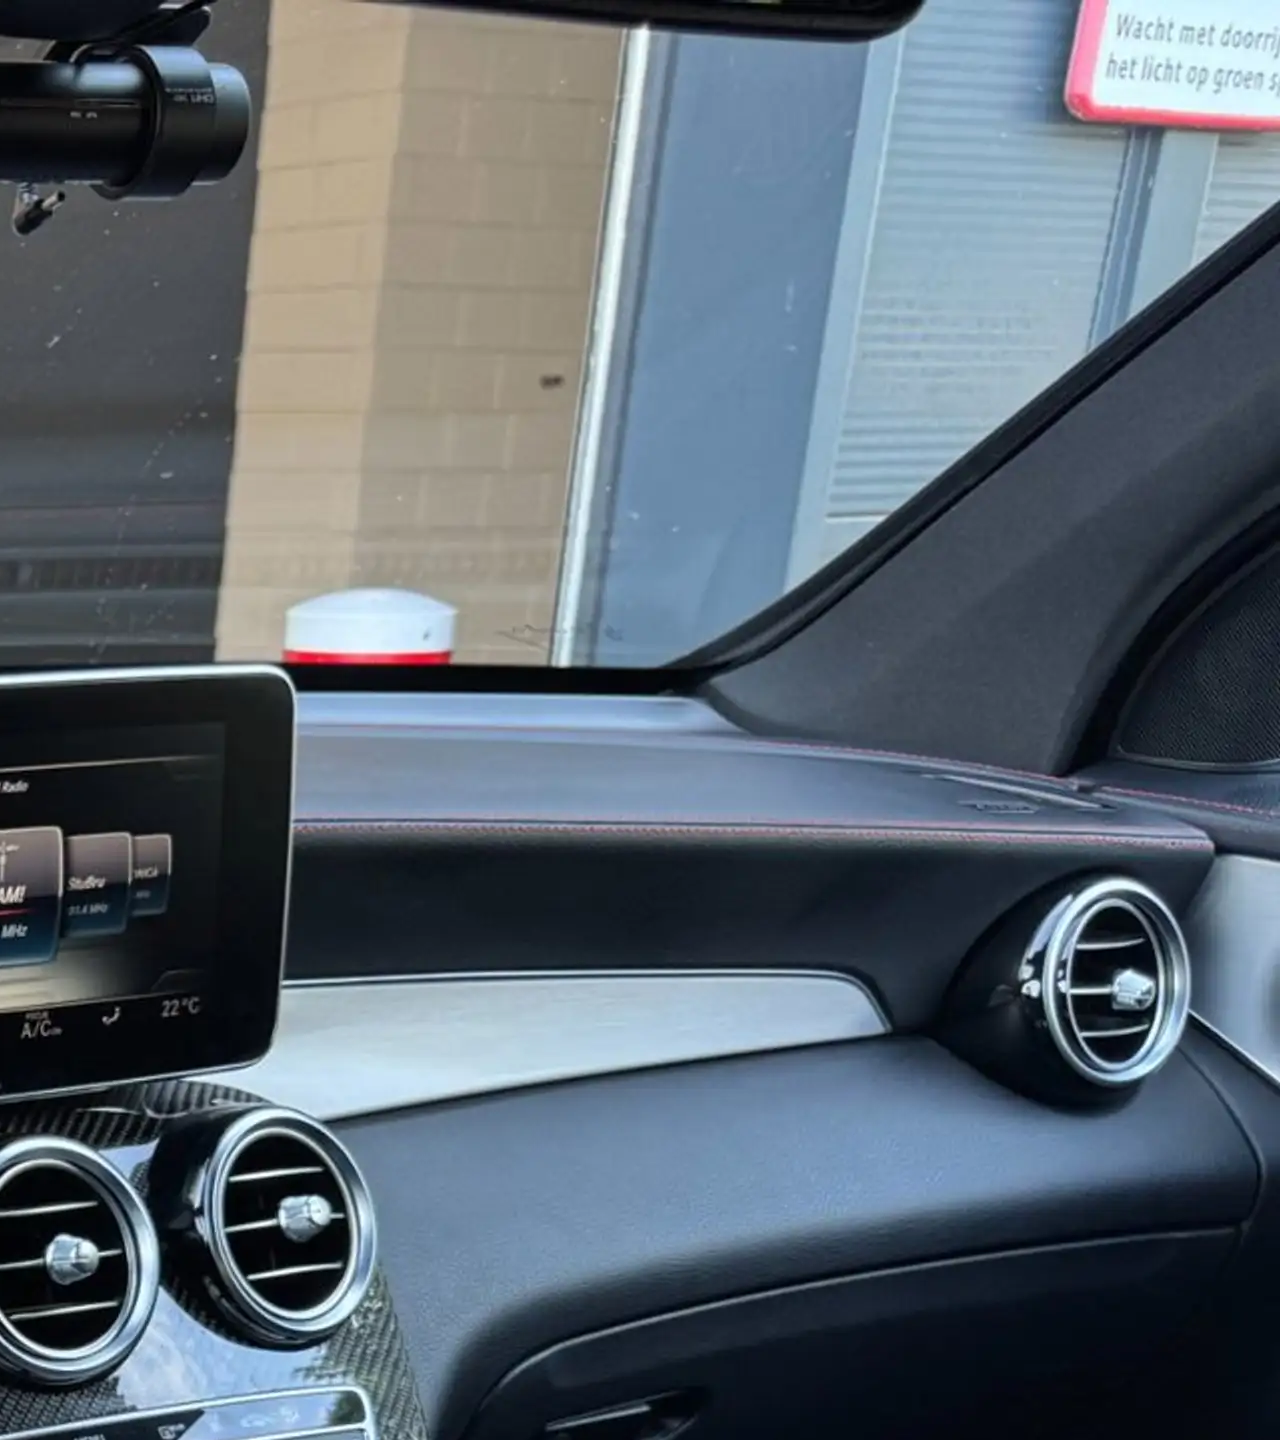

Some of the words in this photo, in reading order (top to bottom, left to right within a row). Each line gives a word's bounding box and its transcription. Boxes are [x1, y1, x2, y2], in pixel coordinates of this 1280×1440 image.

[1116, 13, 1175, 43] Wacht
[1178, 24, 1216, 46] met
[1105, 51, 1137, 80] het
[1140, 55, 1183, 84] licht
[1186, 64, 1209, 91] op
[1213, 68, 1264, 94] groen
[2, 780, 29, 793] Radio
[1, 923, 28, 938] MHz
